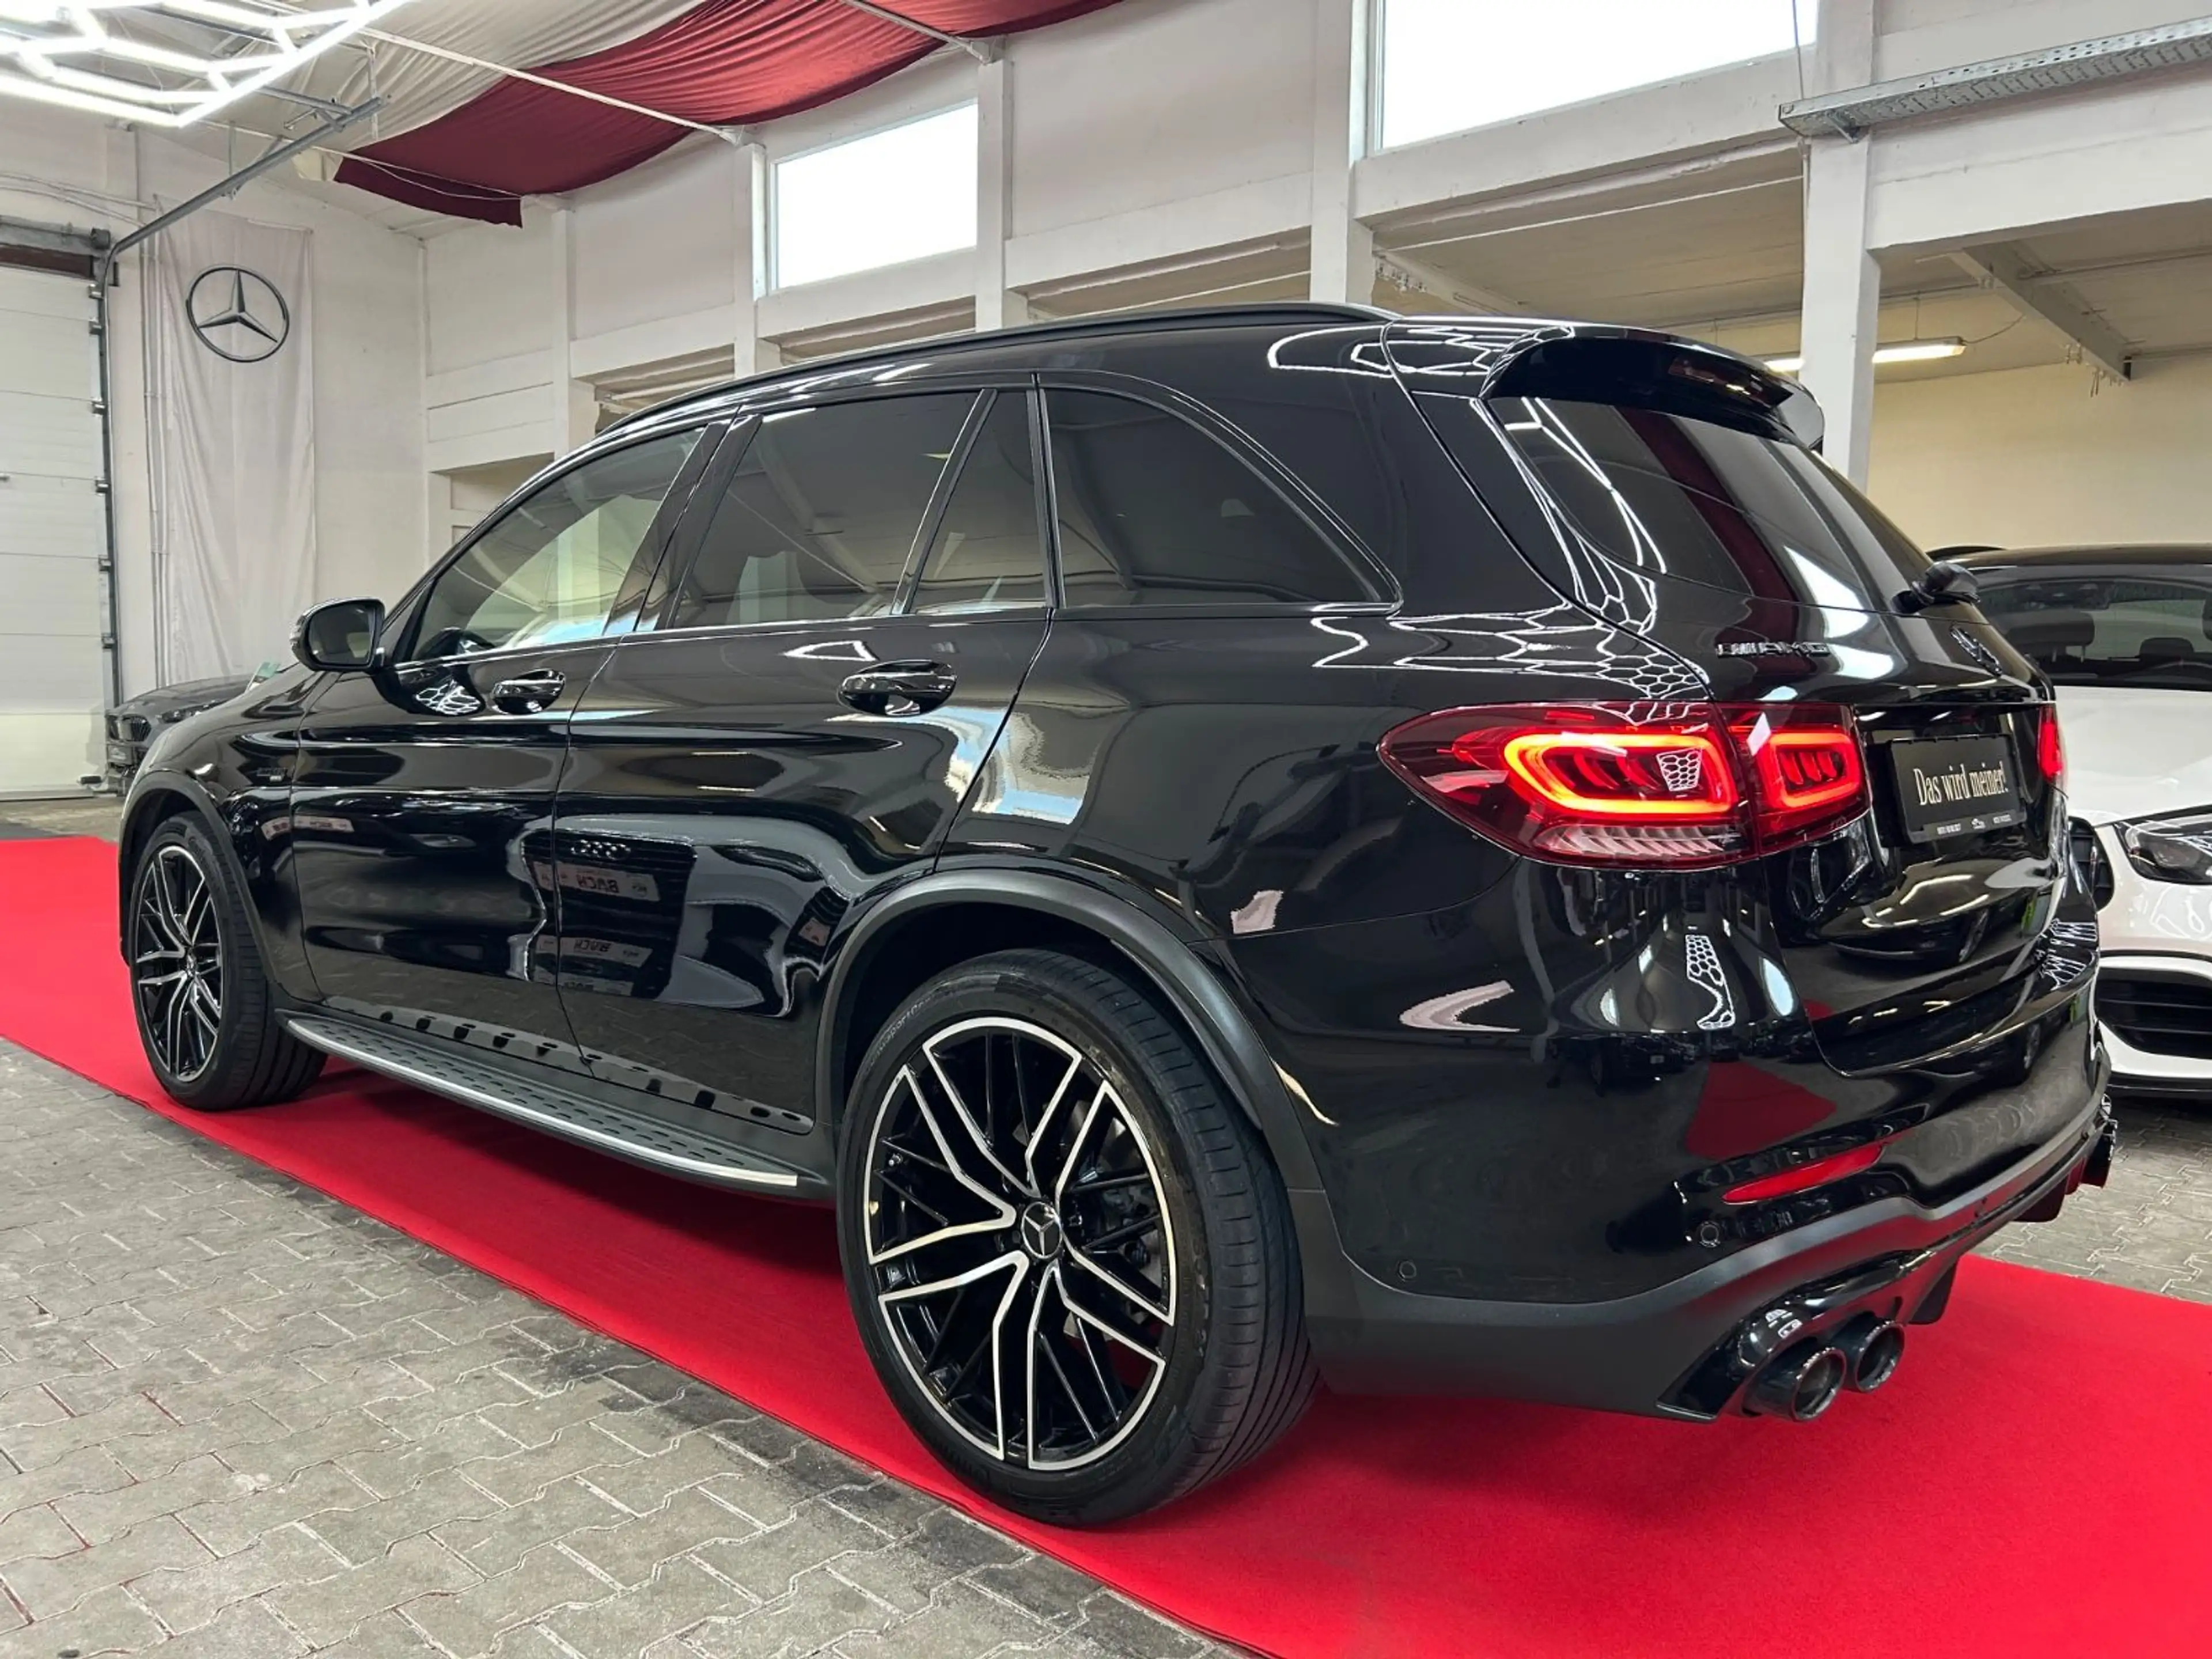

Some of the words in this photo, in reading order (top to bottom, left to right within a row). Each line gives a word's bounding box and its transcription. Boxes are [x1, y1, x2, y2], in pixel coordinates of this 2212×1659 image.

[1913, 768, 1942, 806] Das
[1941, 763, 1971, 801] wird
[1969, 761, 2009, 797] meiner!
